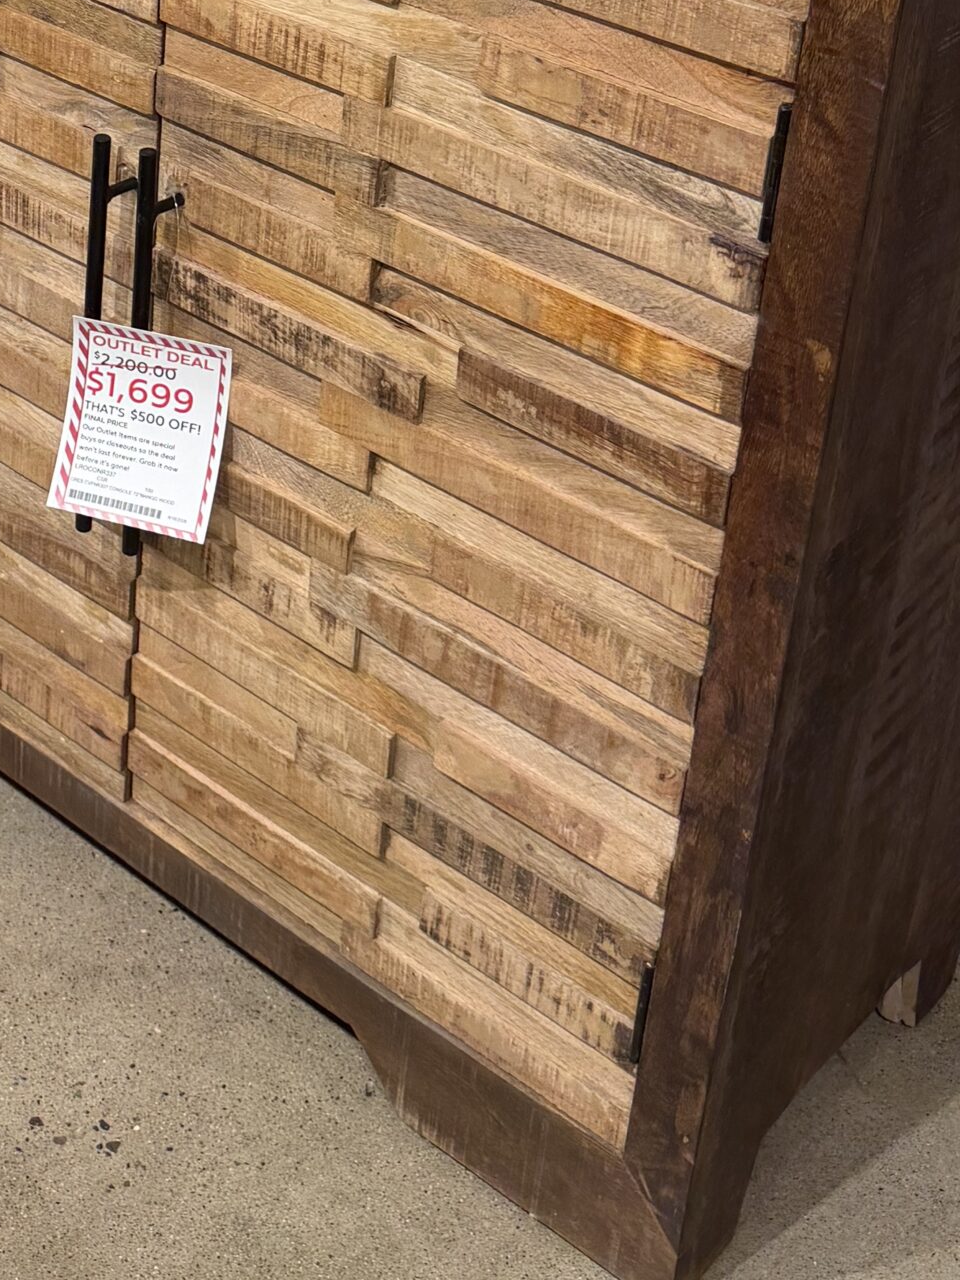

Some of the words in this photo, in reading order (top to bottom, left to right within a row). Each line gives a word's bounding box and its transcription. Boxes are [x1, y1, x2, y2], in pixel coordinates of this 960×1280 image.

[93, 335, 162, 359] OUTLET
[167, 351, 215, 371] DEAL
[94, 350, 177, 380] $2,200.00
[86, 367, 194, 413] $1,699
[84, 413, 105, 424] FINAL
[107, 418, 128, 429] PRICE
[85, 400, 125, 418] THAT'S
[130, 409, 165, 427] $500
[168, 418, 202, 435] OFF!
[80, 434, 96, 443] buys
[106, 440, 137, 452] closeouts
[148, 448, 159, 457] the
[160, 452, 176, 461] deal
[82, 423, 95, 431] Our
[96, 426, 117, 437] Outlet
[152, 440, 176, 450] special
[76, 454, 99, 464] before
[100, 459, 110, 467] it's
[110, 463, 130, 472] gone!
[79, 445, 98, 454] won't
[98, 448, 111, 457] last
[112, 451, 137, 462] forever.
[139, 458, 157, 467] Grab
